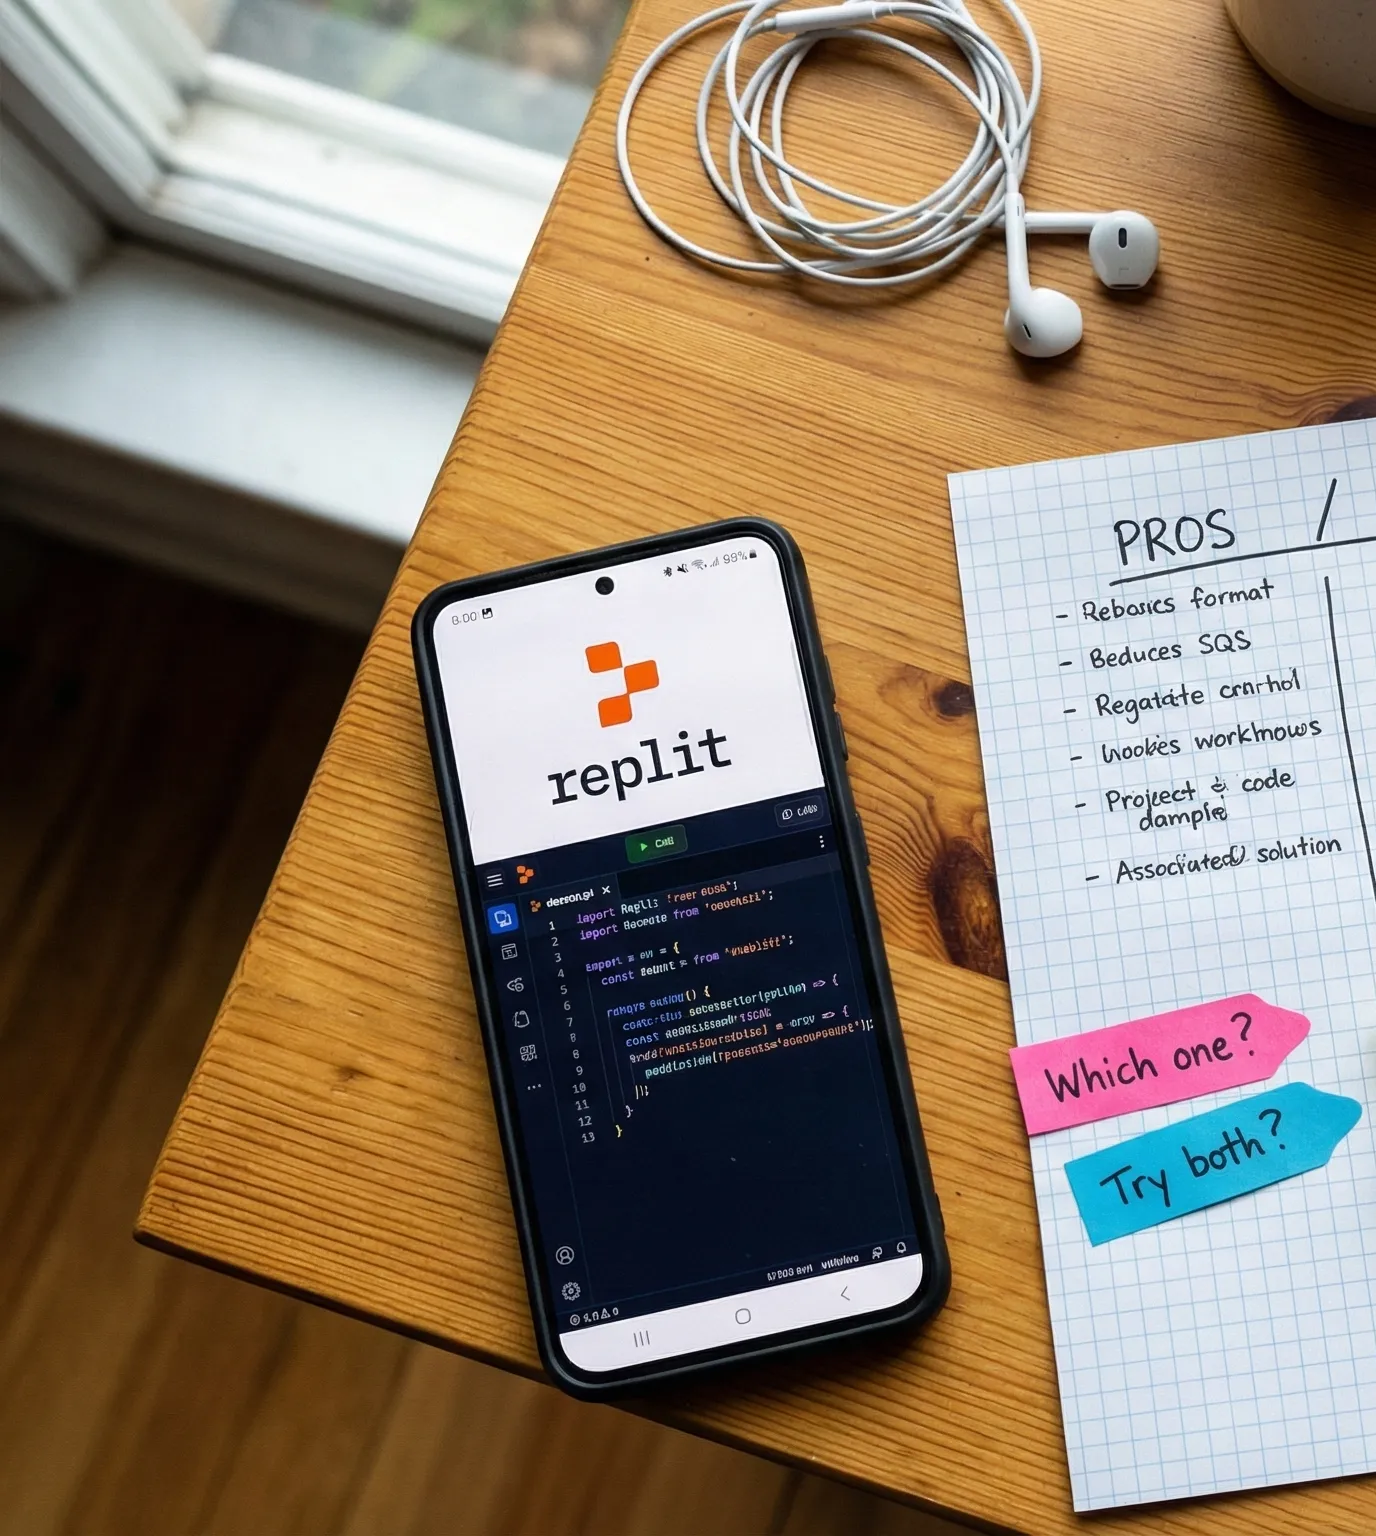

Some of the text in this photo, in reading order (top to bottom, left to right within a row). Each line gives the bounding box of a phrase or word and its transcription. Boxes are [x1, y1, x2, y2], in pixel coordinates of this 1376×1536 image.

[1114, 509, 1236, 566] PROS
[1190, 578, 1275, 609] format
[1199, 629, 1252, 655] SQS
[547, 728, 732, 806] replit
[1105, 780, 1196, 813] Project
[1242, 768, 1296, 793] code
[1257, 836, 1342, 863] solution
[548, 921, 556, 931] 1
[551, 937, 560, 947] 2
[555, 953, 562, 963] 3
[560, 985, 568, 995] 5
[563, 1001, 571, 1011] 6
[566, 1017, 573, 1027] 7
[1043, 1011, 1256, 1103] Which one?
[576, 1066, 583, 1076] 9
[572, 1082, 587, 1094] 10
[578, 1115, 593, 1127] 12
[581, 1132, 596, 1143] 13
[1099, 1108, 1287, 1208] Try both?
